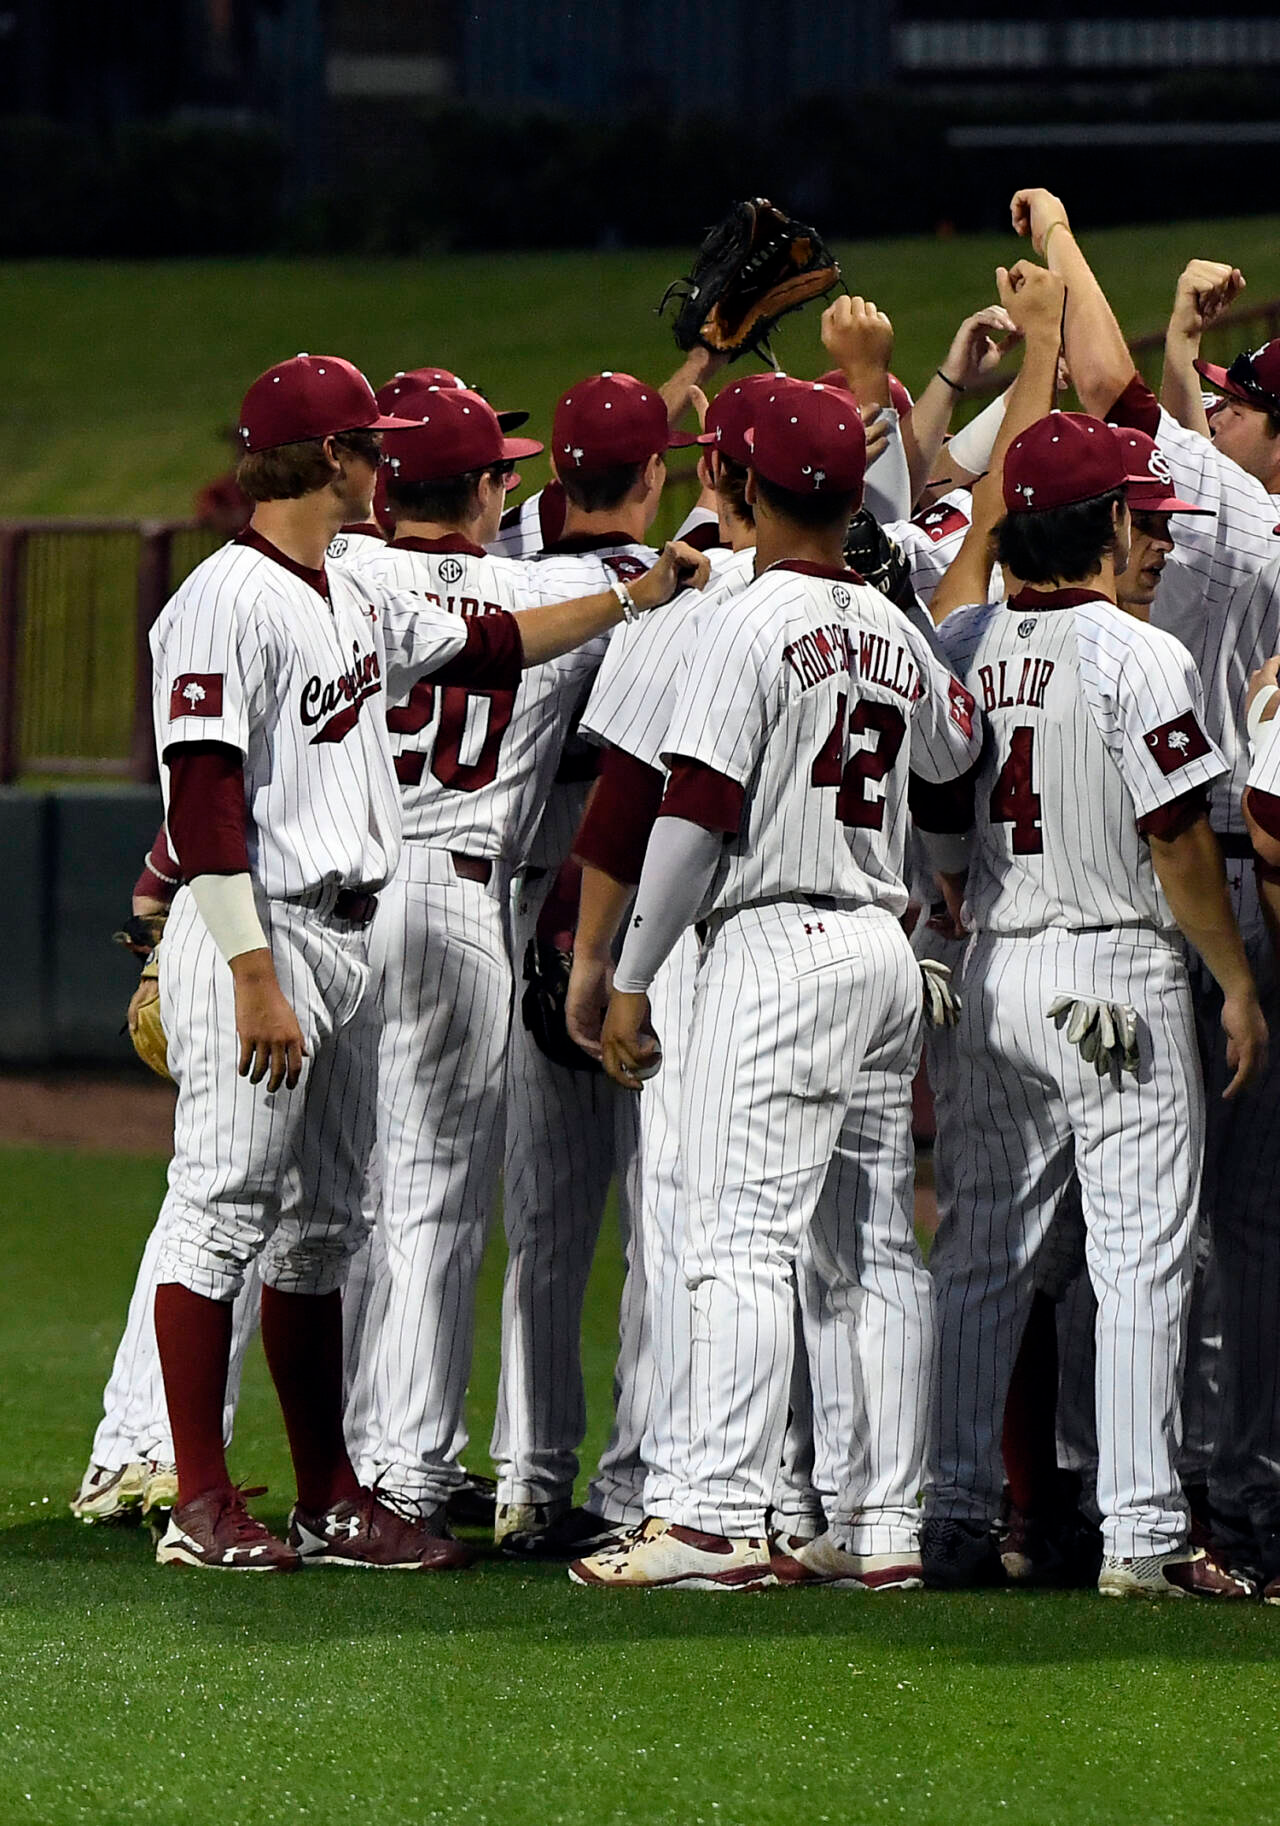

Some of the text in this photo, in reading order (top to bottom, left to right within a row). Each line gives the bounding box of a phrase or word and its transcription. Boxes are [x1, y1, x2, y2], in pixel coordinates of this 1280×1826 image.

[386, 682, 517, 792] 20
[811, 691, 907, 832] 42
[989, 726, 1044, 855] 4
